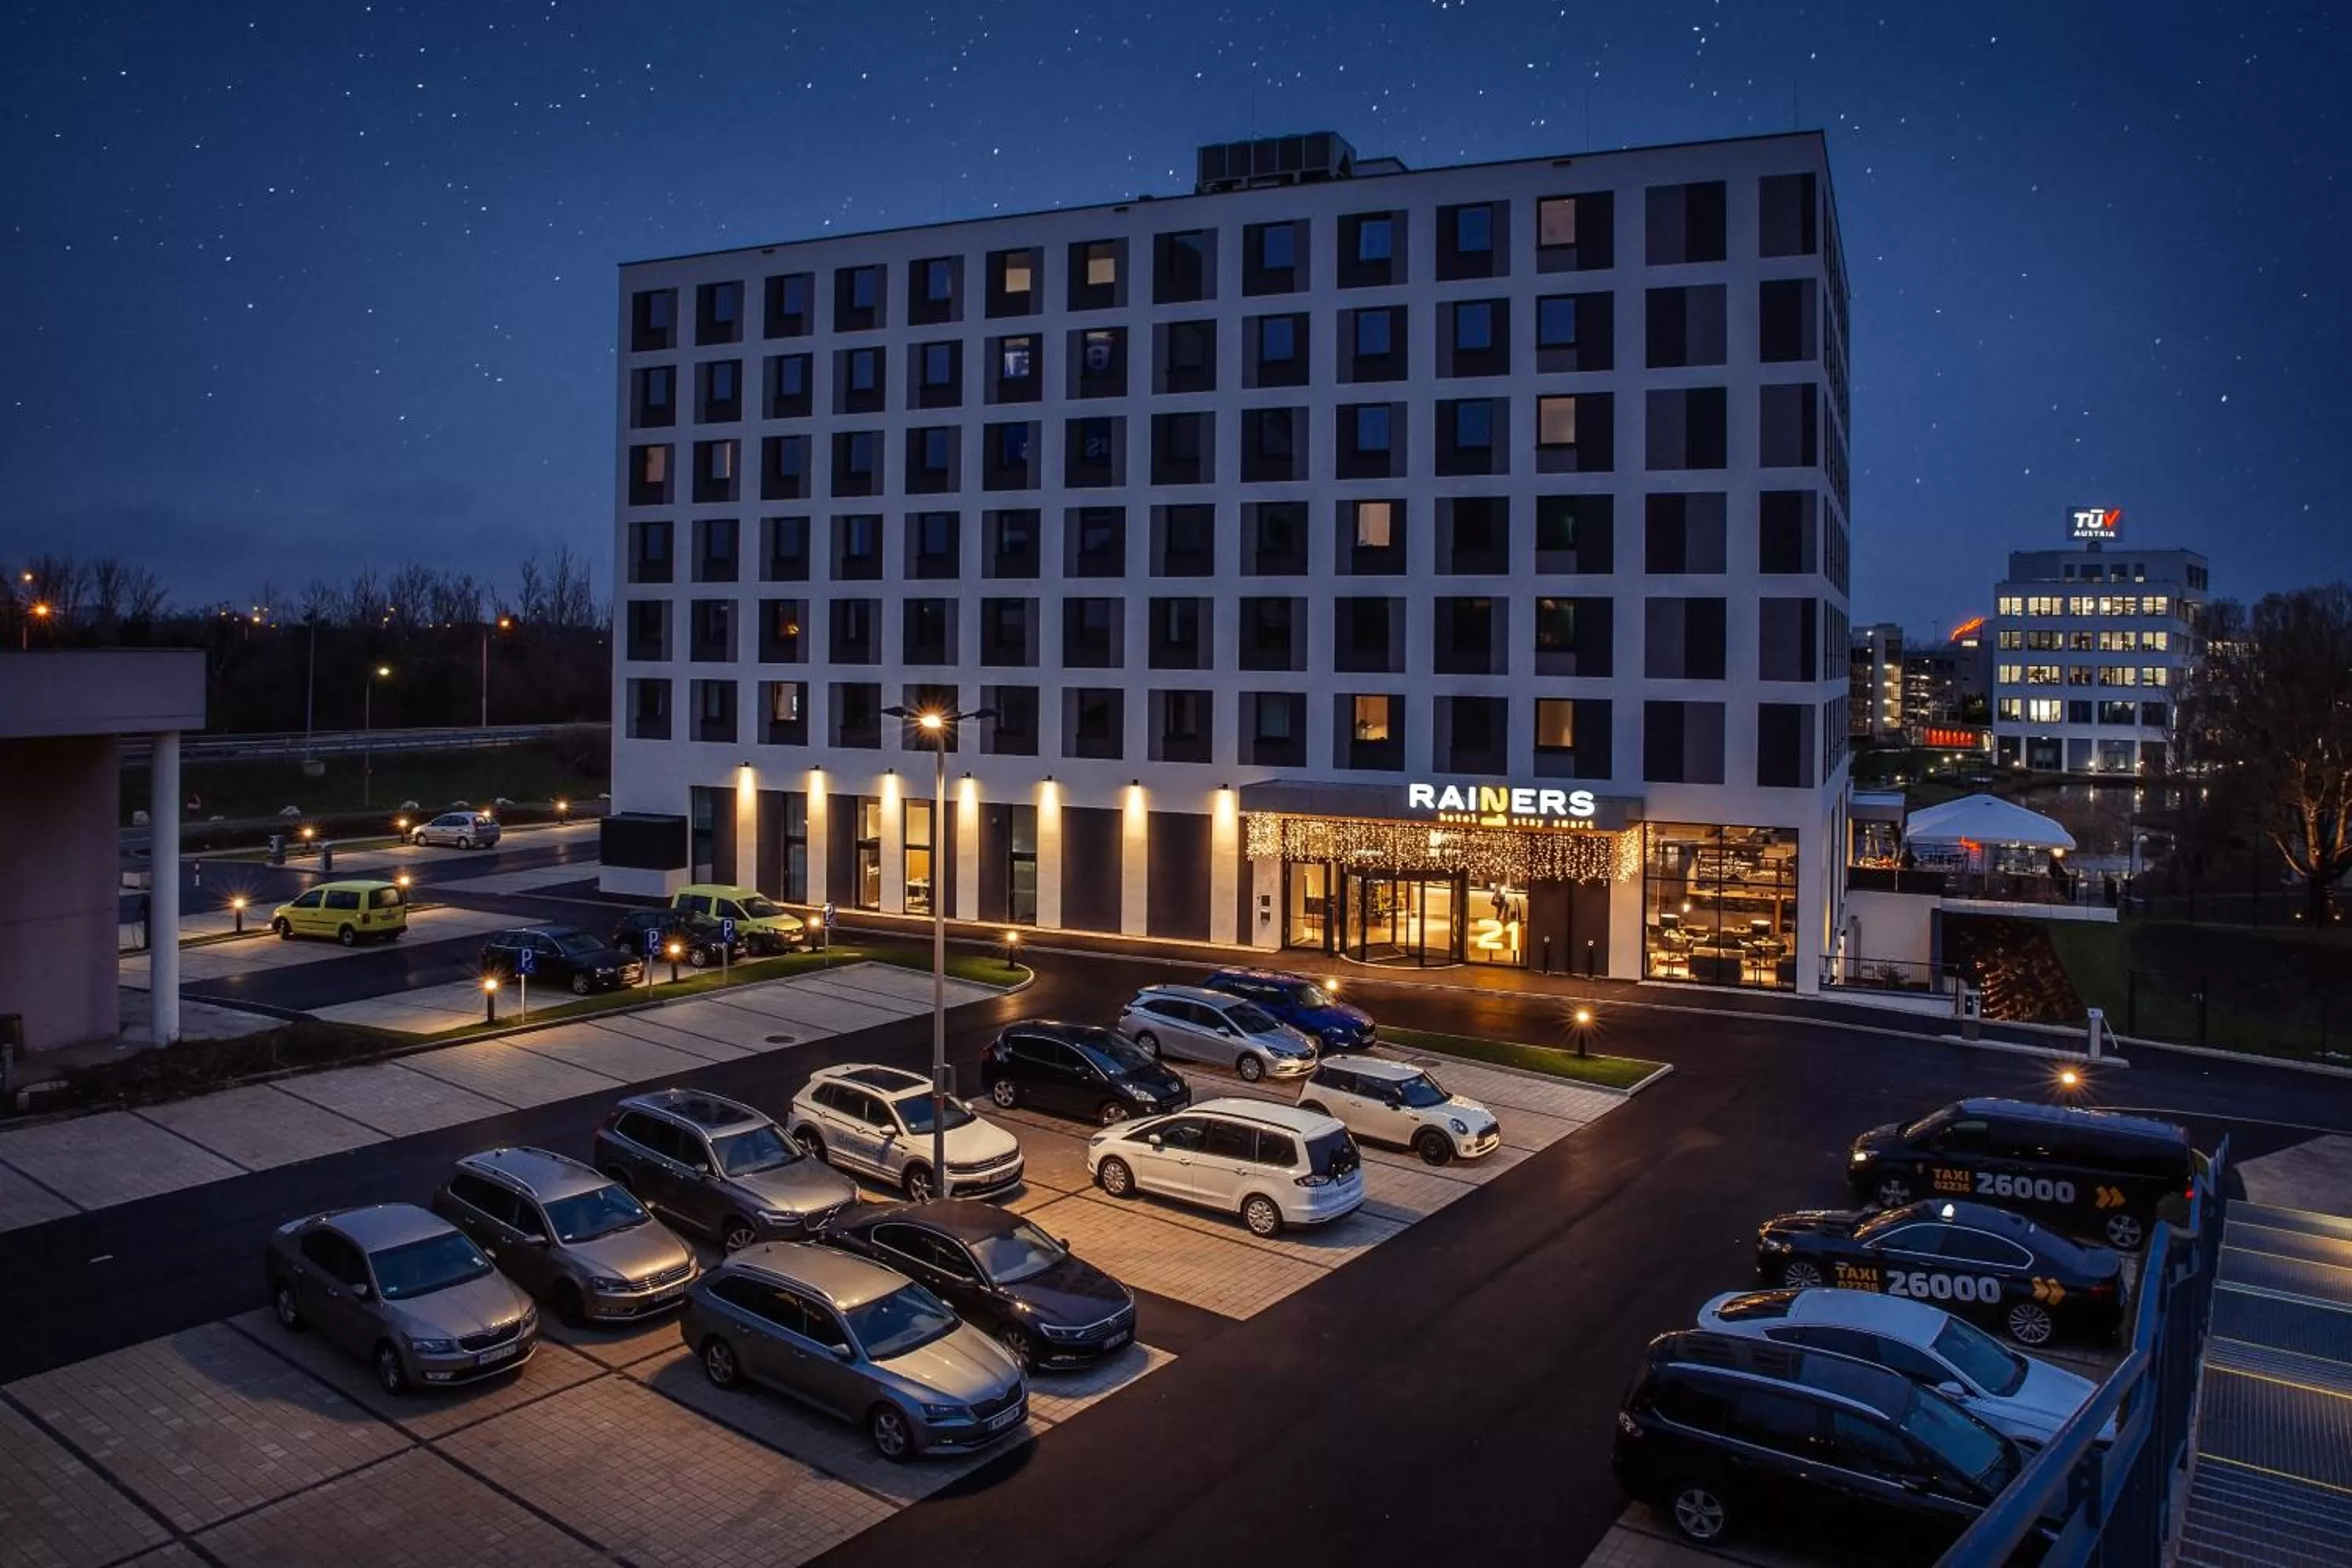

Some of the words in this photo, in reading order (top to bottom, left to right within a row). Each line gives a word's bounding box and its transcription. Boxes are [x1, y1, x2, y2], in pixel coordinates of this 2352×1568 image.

[1409, 783, 1595, 816] RAINERS
[1439, 812, 1477, 823] hotel
[1512, 817, 1544, 828] stay
[1553, 818, 1594, 829] smart
[724, 920, 733, 937] P
[1476, 919, 1519, 950] 21
[649, 931, 659, 949] P
[521, 949, 532, 968] P
[1932, 1168, 1969, 1181] TAXI
[1976, 1173, 2075, 1203] 26000
[1835, 1266, 1878, 1280] TAXI
[1886, 1270, 2001, 1303] 26000
